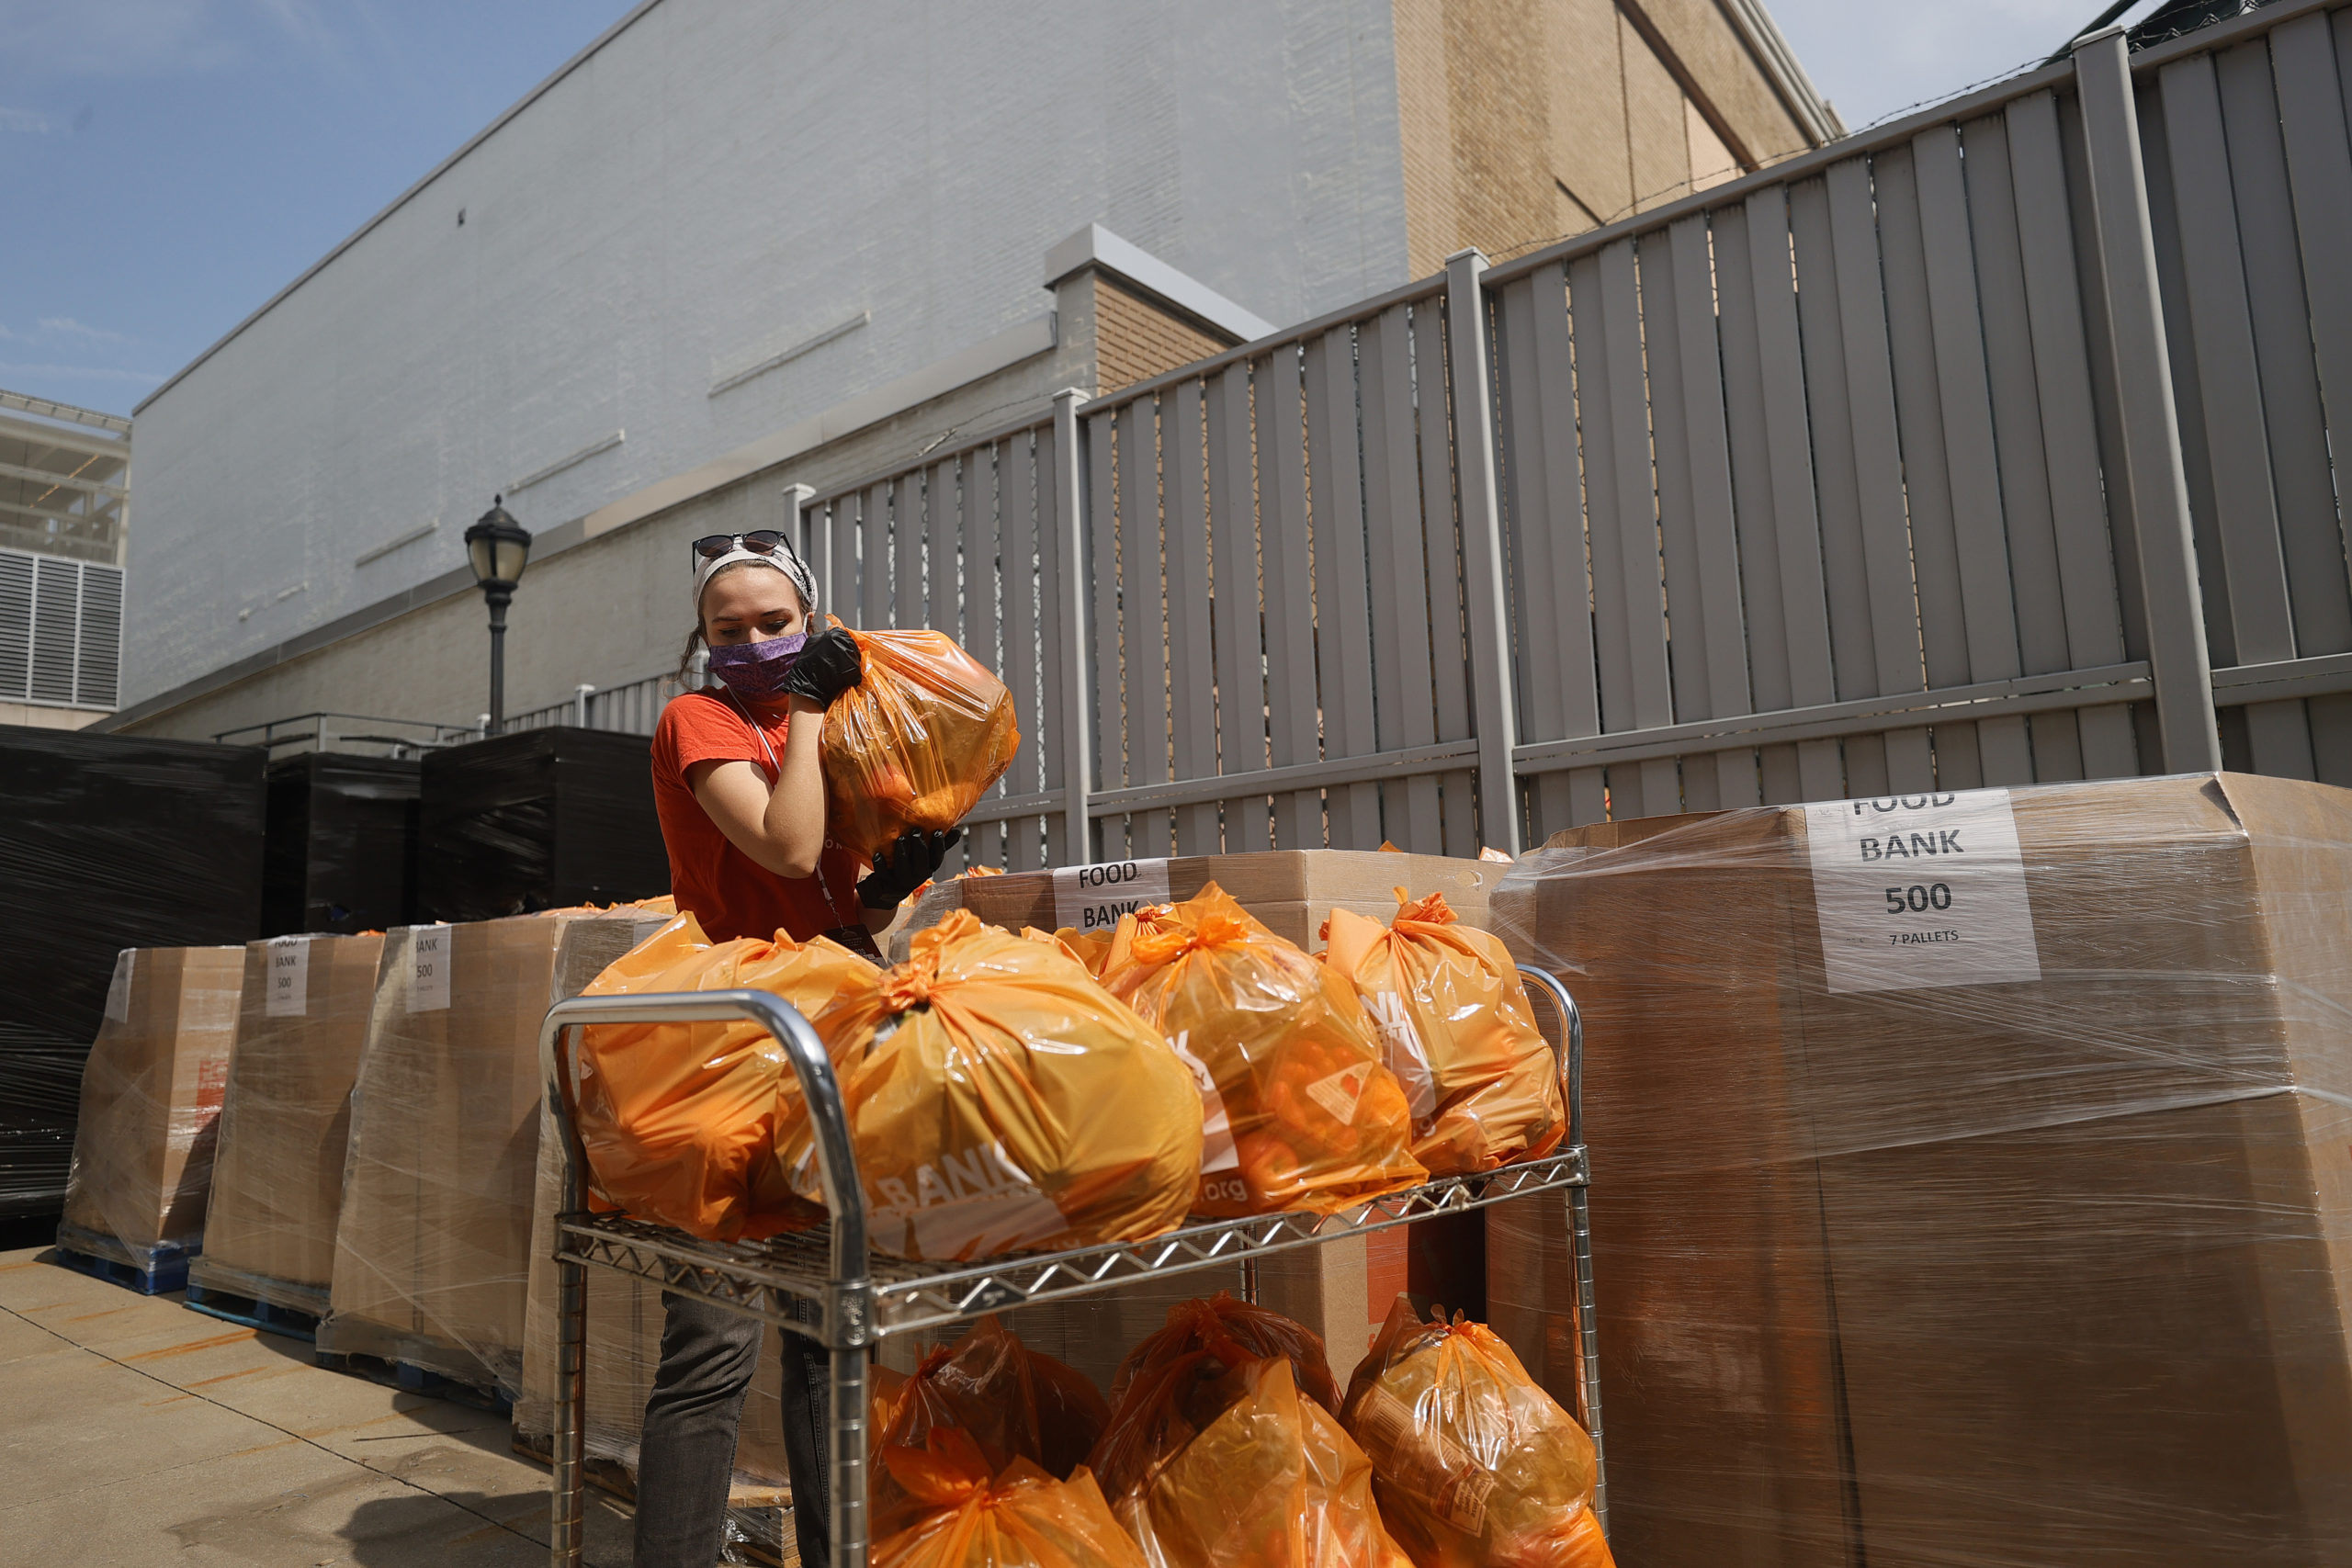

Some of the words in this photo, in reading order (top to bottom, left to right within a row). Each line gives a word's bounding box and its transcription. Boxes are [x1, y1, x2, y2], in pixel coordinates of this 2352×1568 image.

[1860, 829, 1965, 862] BANK
[1079, 862, 1137, 889] FOOD
[1885, 883, 1952, 915] 500
[1889, 934, 1897, 945] 7
[1902, 930, 1959, 944] PALLETS
[417, 964, 433, 978] 500
[277, 976, 291, 989] 500
